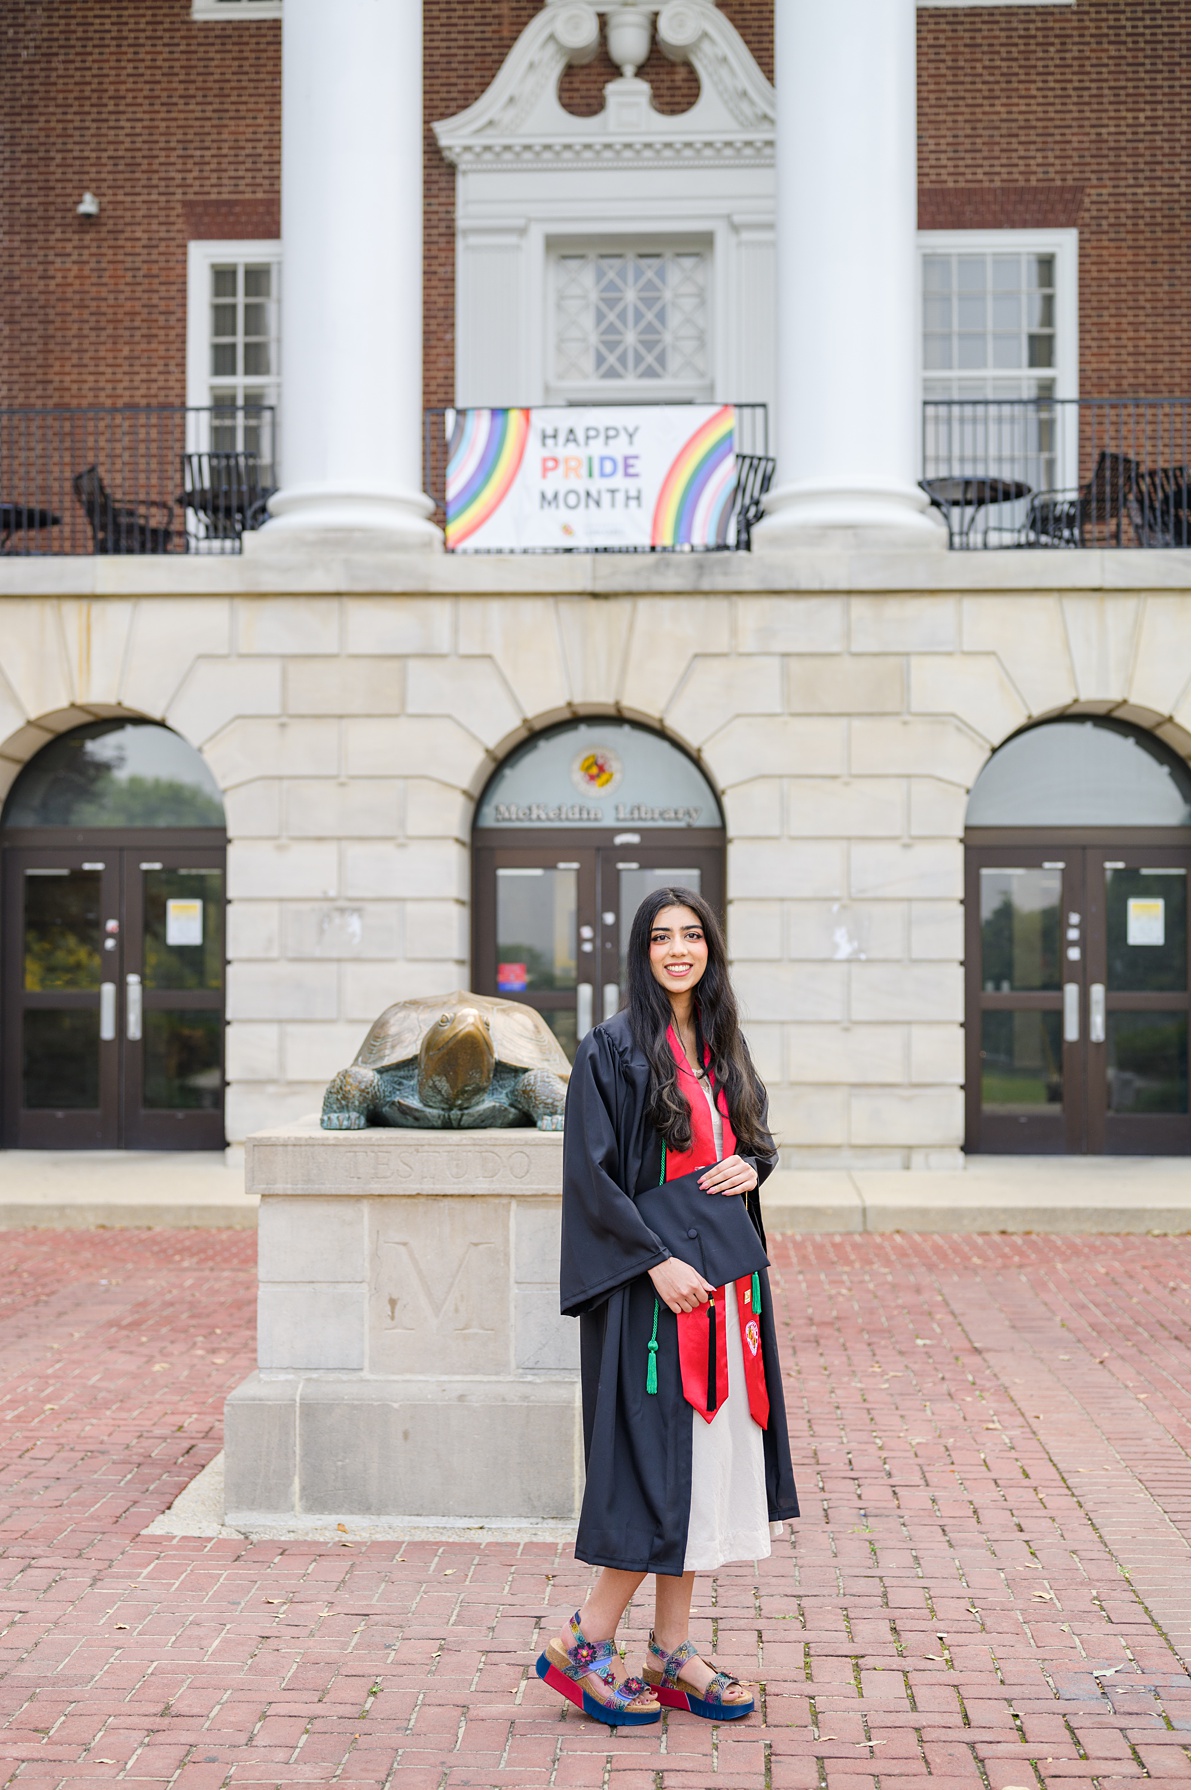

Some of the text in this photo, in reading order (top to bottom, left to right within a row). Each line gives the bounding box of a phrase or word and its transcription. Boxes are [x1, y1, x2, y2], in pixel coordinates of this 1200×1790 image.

[541, 426, 640, 447] HAPPY
[541, 455, 640, 480] PRIDE
[540, 488, 642, 510] MONTH
[495, 803, 701, 827] McKeldin Library
[346, 1150, 532, 1179] TESTUDO
[383, 1241, 495, 1333] M
